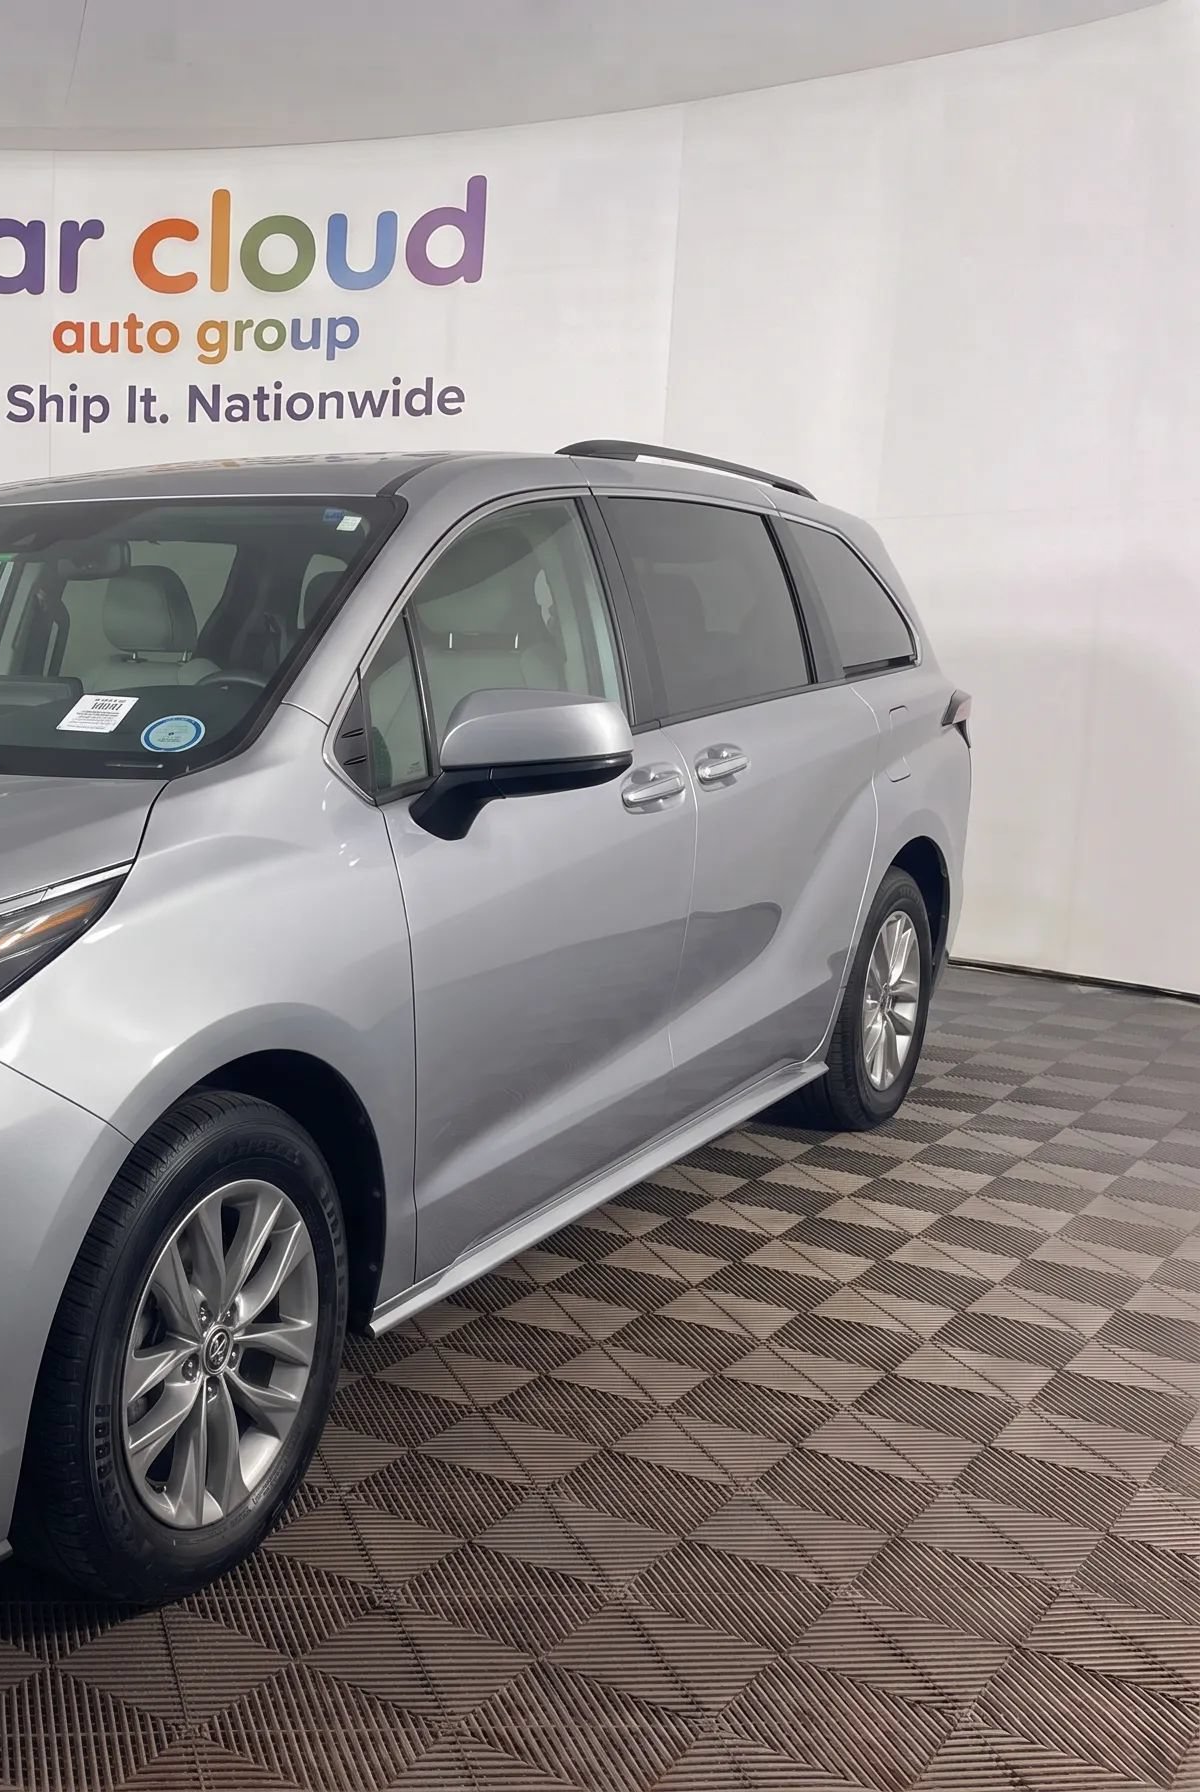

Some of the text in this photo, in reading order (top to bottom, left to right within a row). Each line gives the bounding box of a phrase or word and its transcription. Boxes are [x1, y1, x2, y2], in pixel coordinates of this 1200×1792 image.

[132, 174, 488, 295] cloud
[52, 312, 360, 365] auto group
[6, 383, 110, 434] Ship
[127, 385, 169, 424] It.
[188, 376, 465, 423] Nationwide
